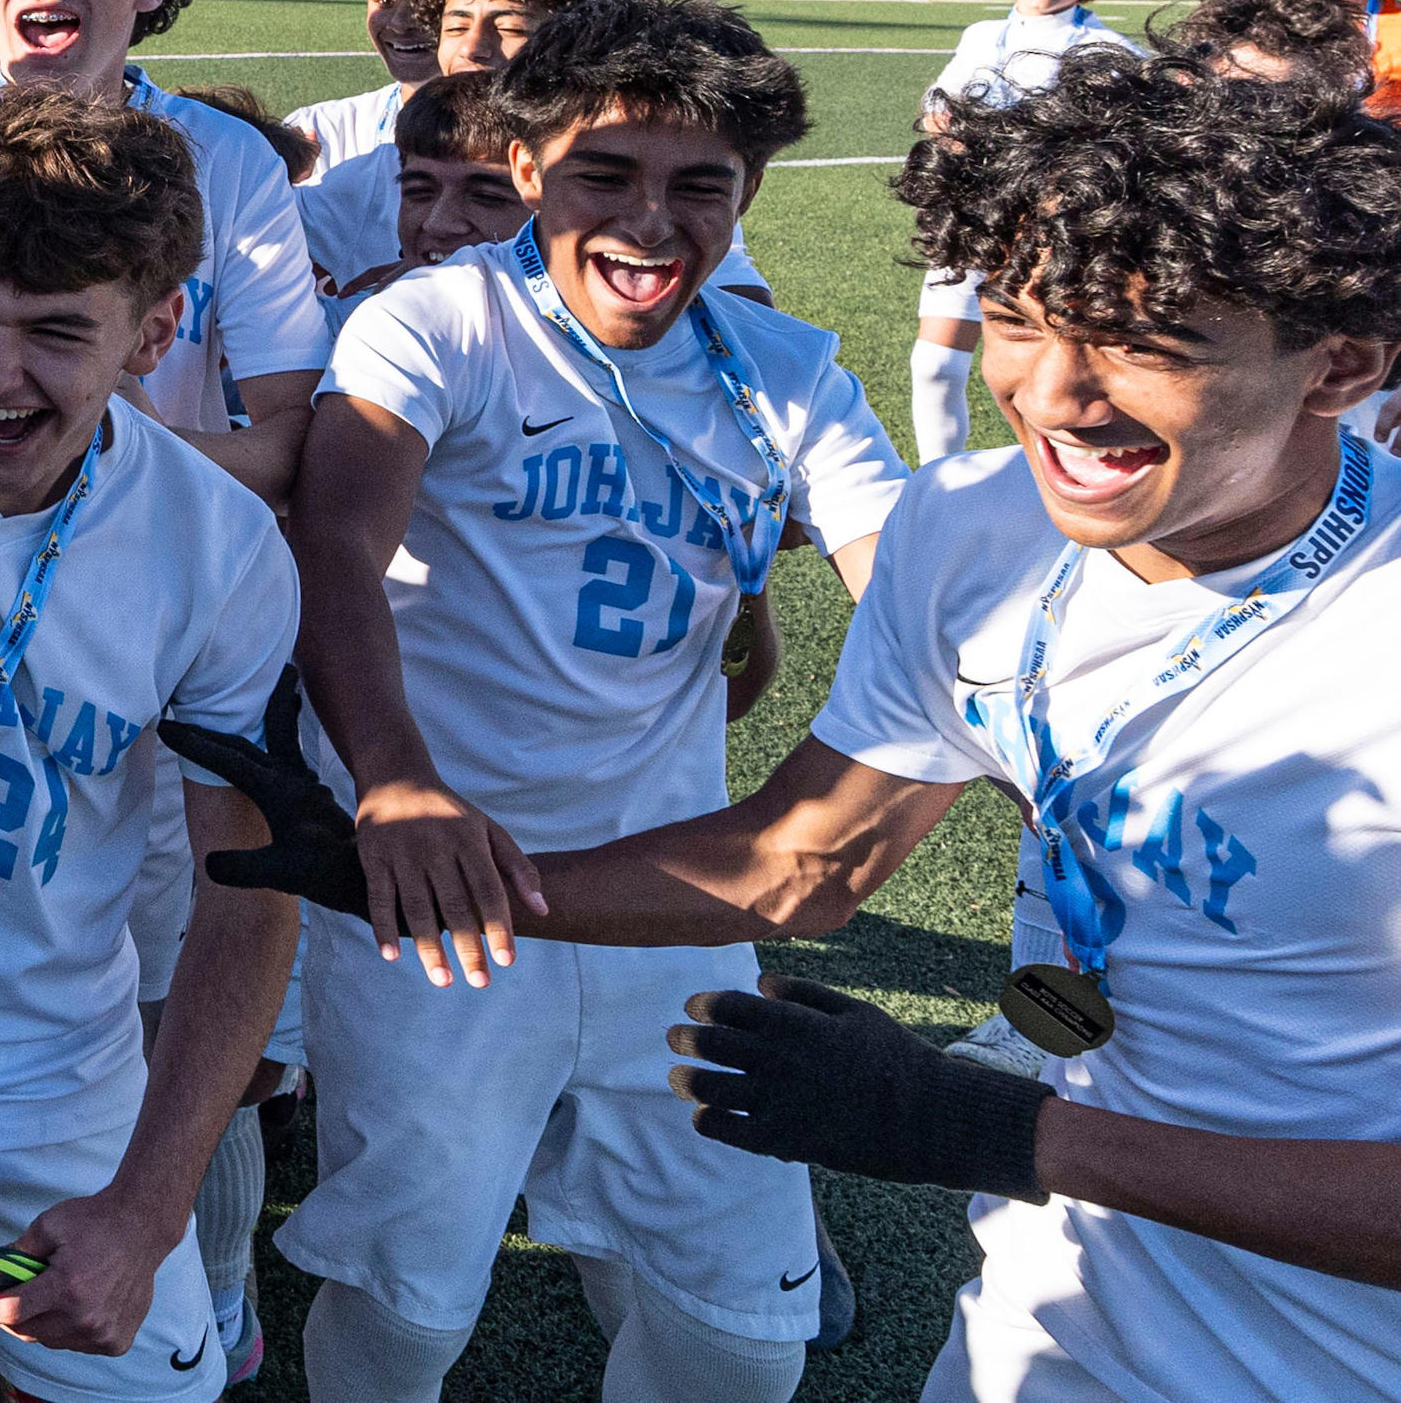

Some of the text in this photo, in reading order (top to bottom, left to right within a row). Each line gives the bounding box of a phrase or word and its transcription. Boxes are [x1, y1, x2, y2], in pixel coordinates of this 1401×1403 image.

[493, 443, 641, 522] JOH
[1214, 599, 1266, 640] NYSPHSAA
[1024, 639, 1047, 693] NYSPHSAA
